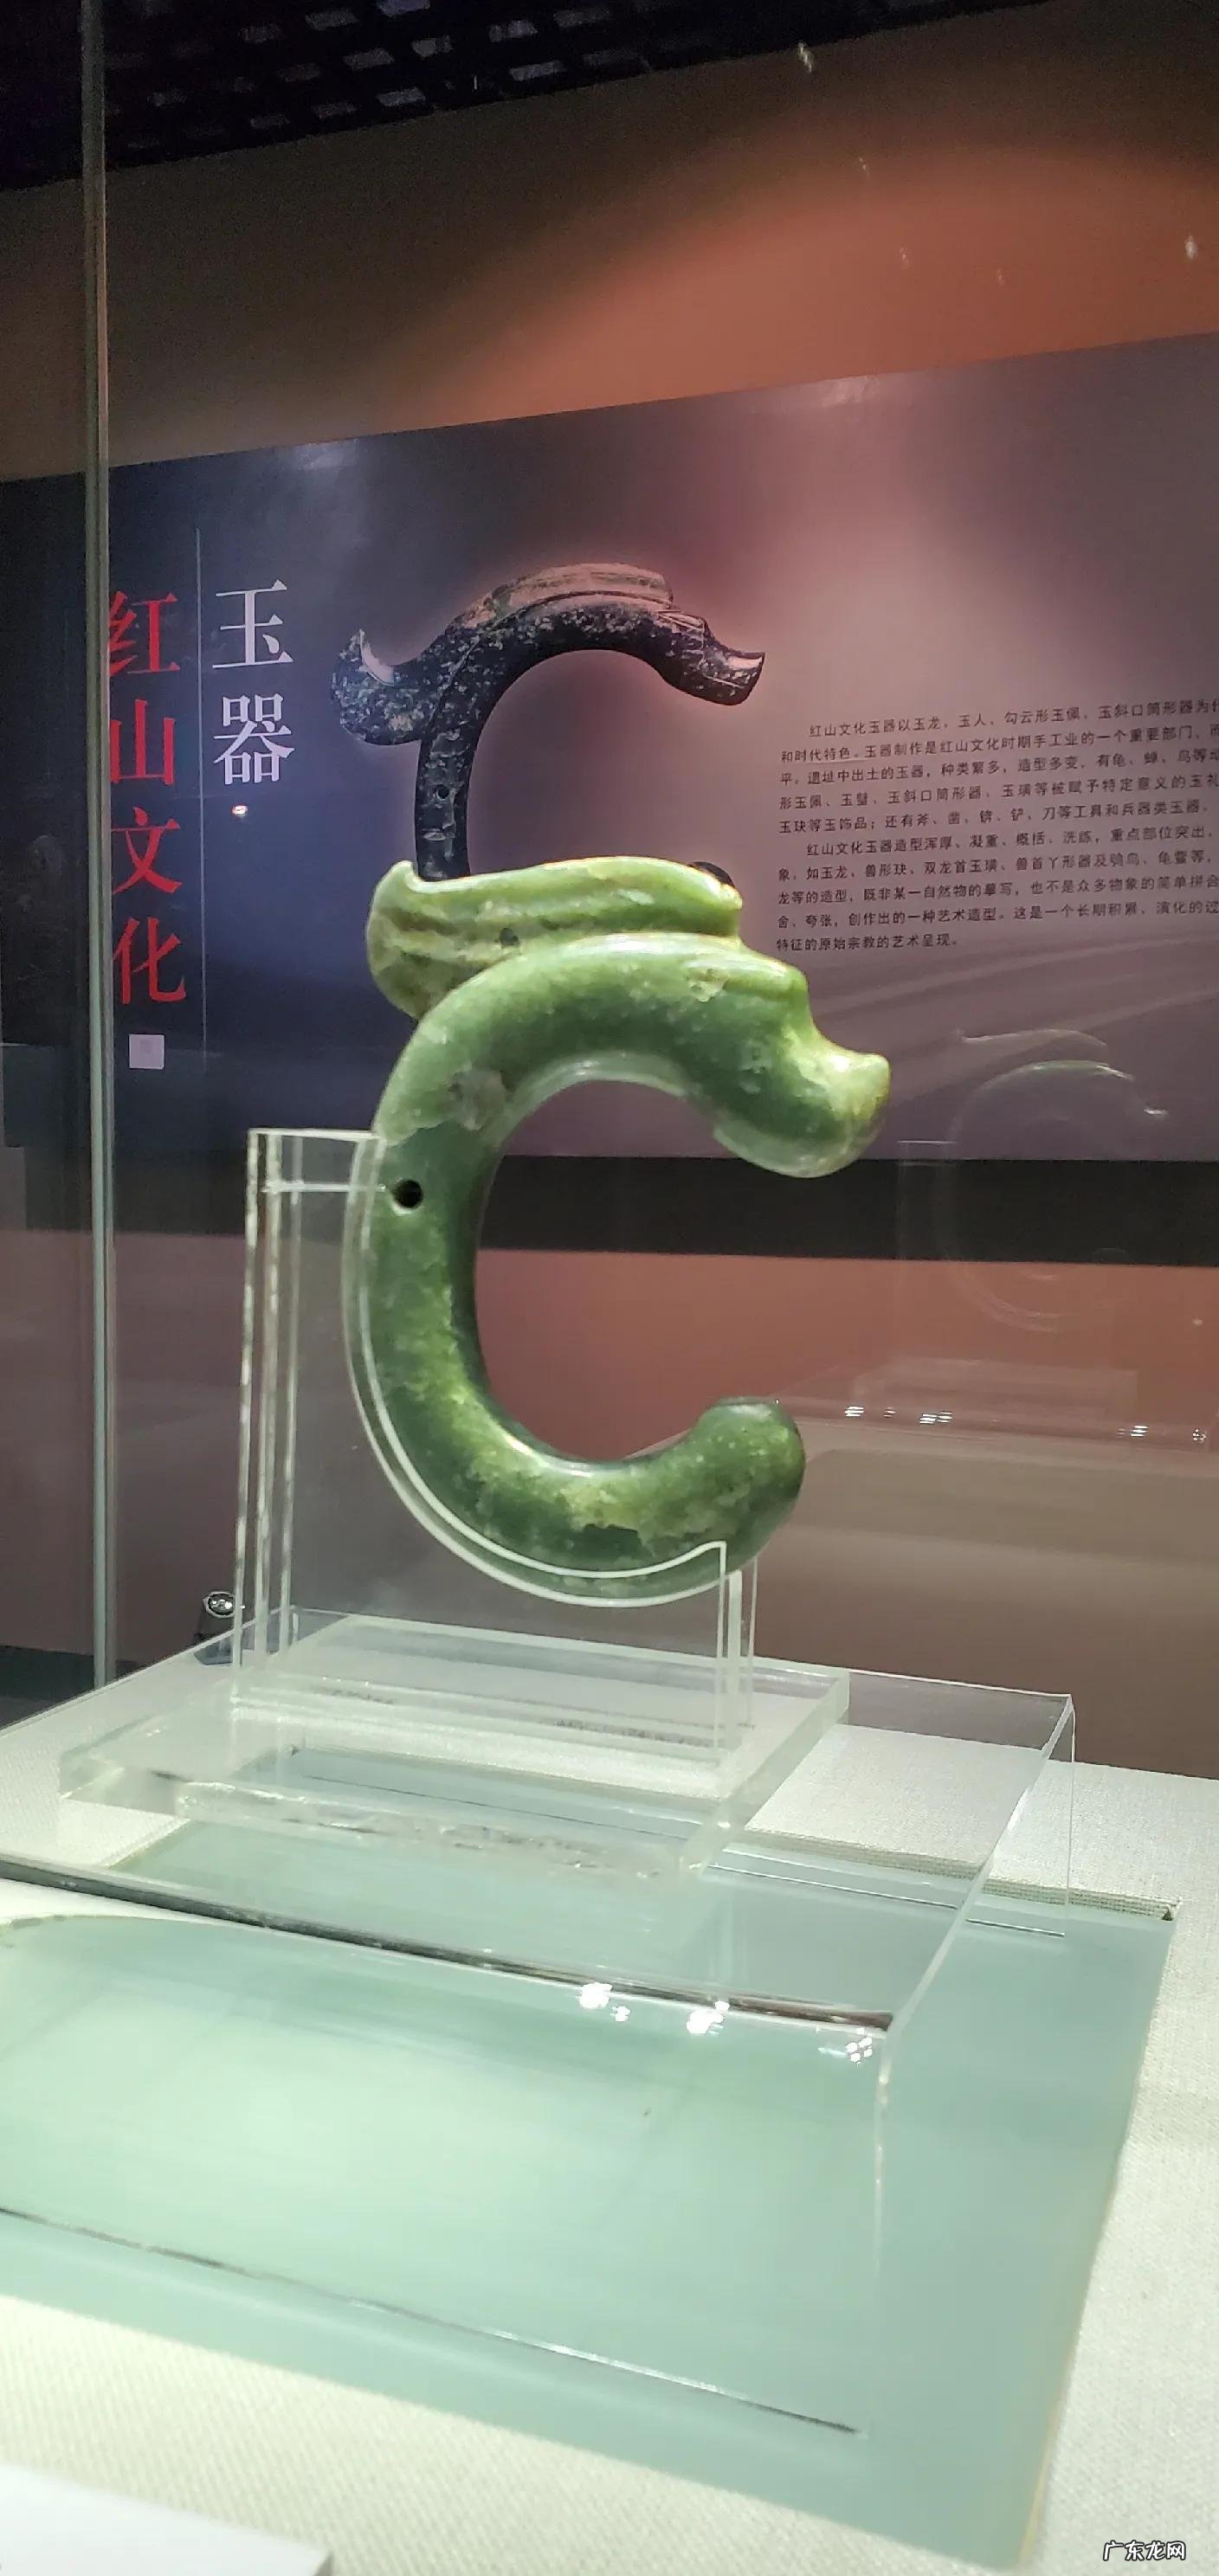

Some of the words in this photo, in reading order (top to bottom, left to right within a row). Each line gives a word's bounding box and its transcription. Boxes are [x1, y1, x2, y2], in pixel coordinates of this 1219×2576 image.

[109, 590, 186, 1005] 红山文化
[212, 578, 293, 785] 玉器
